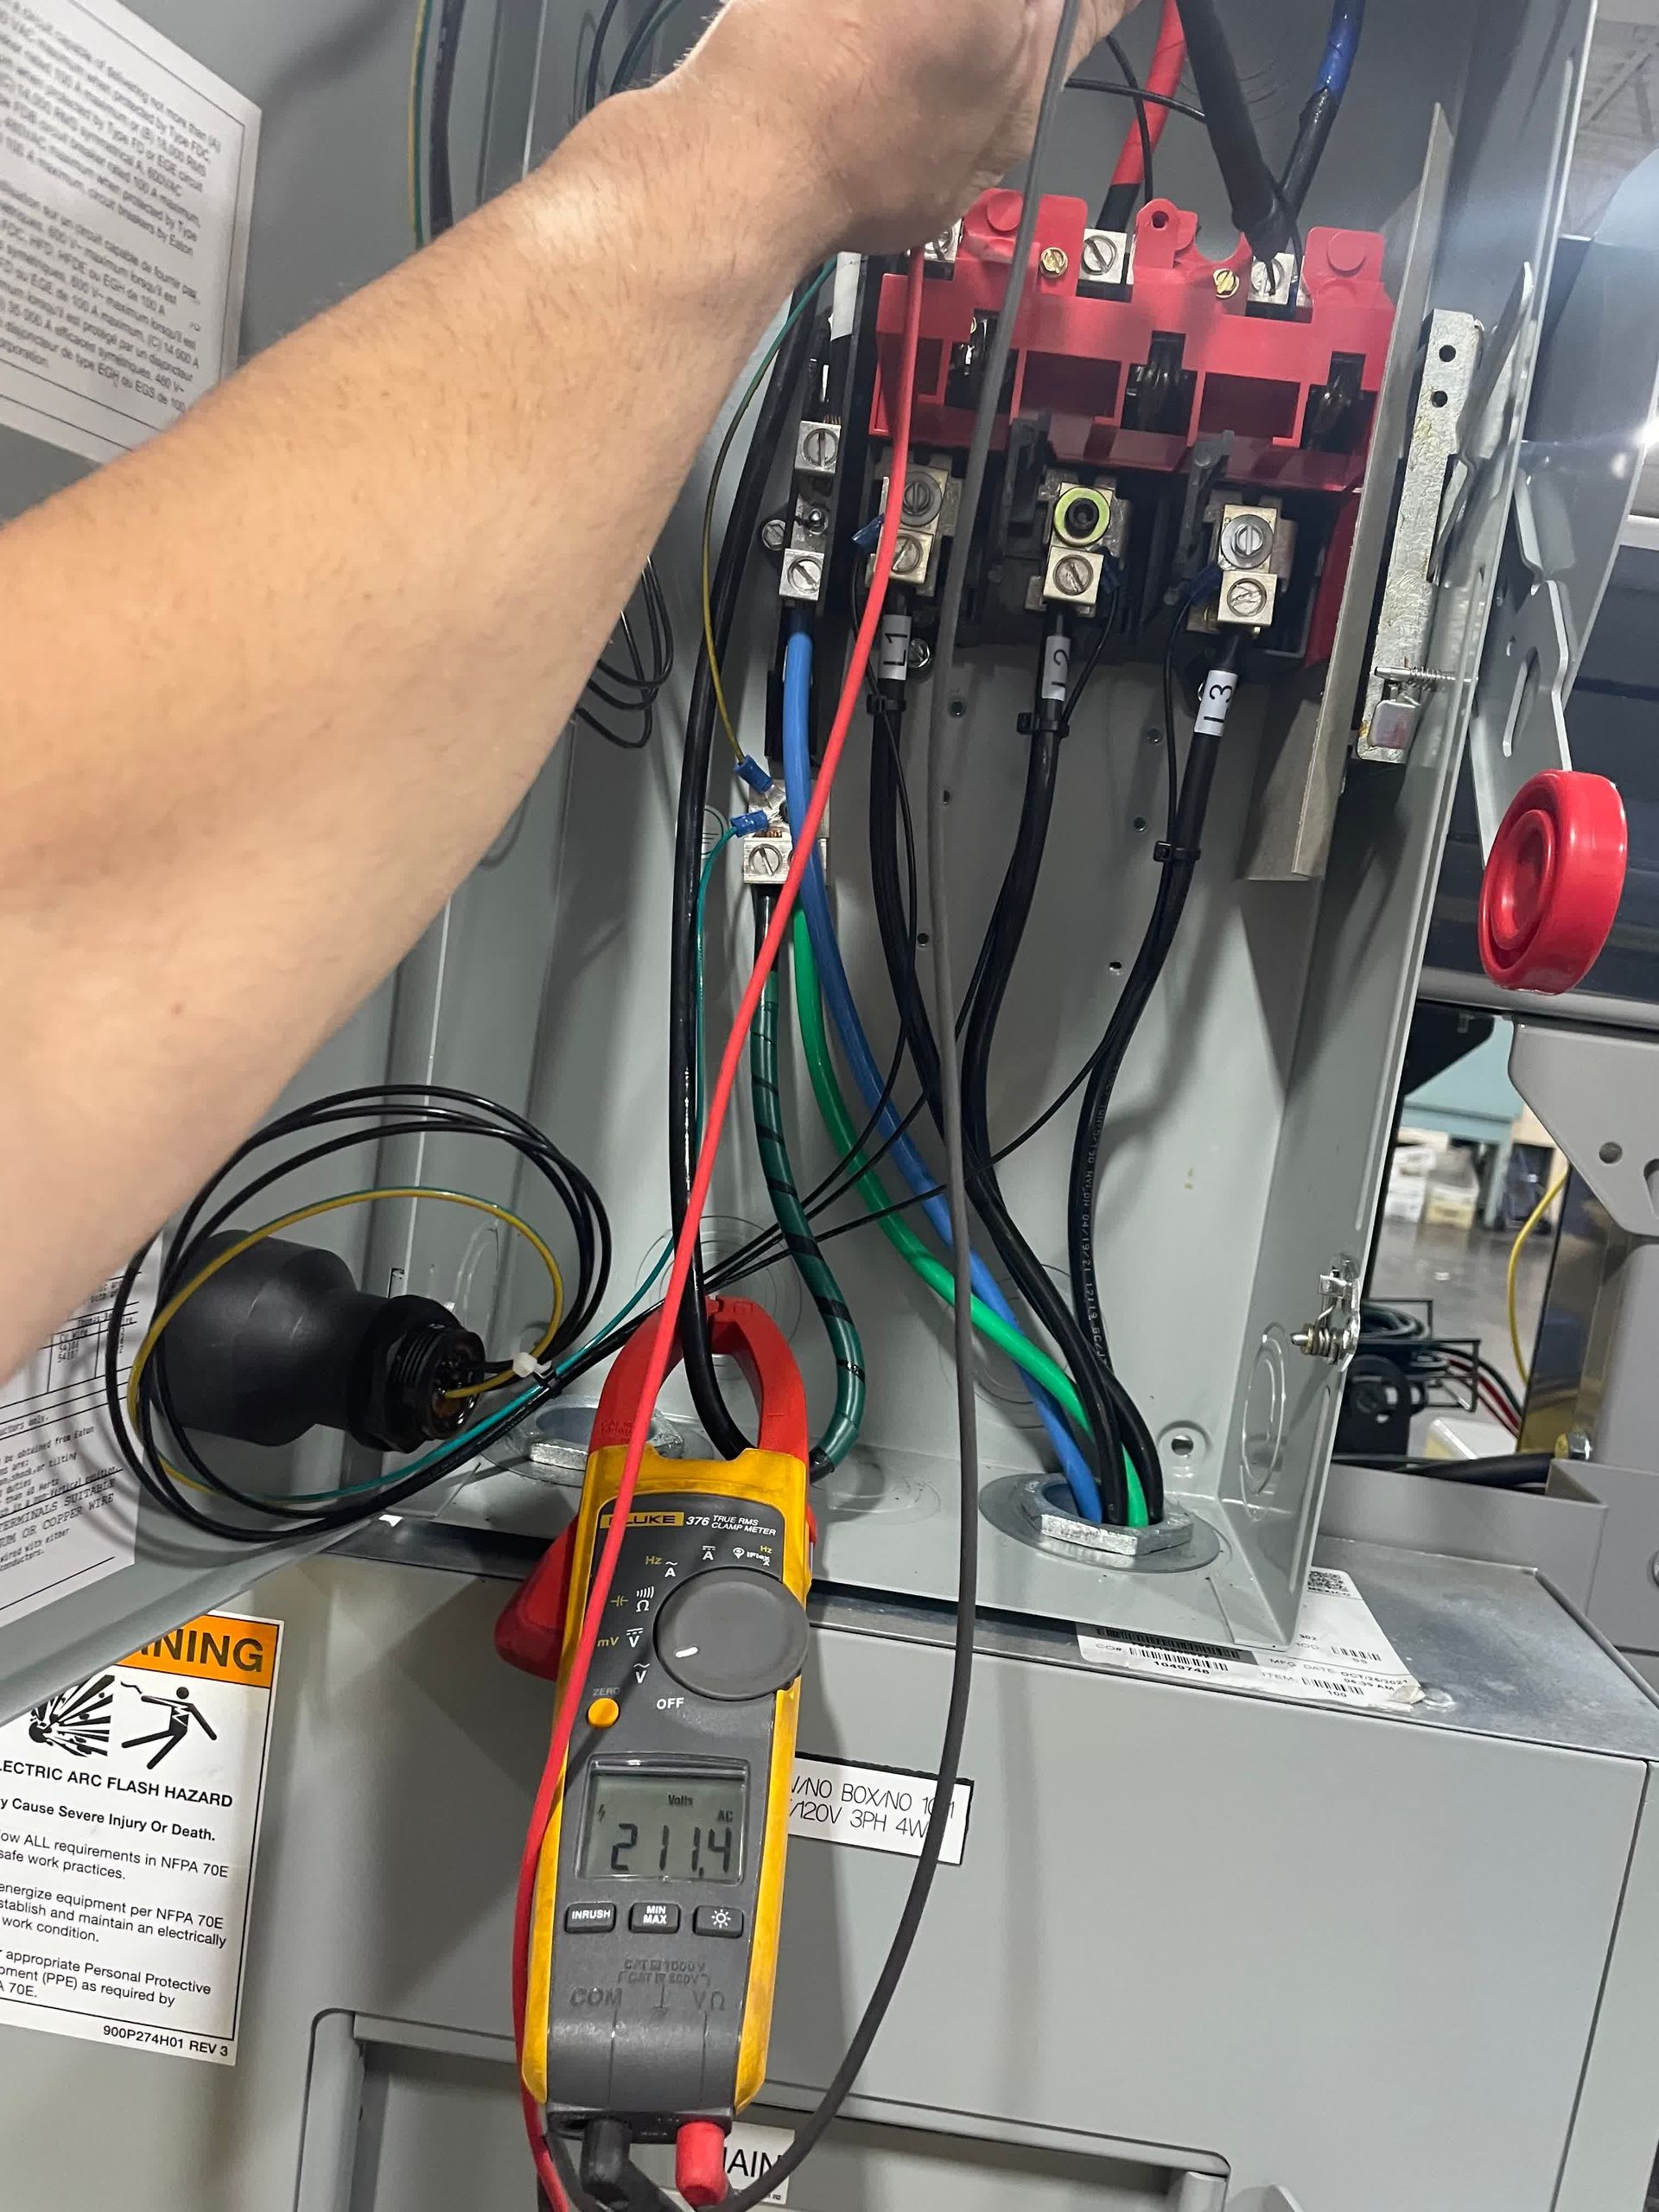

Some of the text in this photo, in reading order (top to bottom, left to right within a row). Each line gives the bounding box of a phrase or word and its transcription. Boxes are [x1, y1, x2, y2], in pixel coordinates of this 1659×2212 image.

[883, 632, 908, 666] L1
[42, 1506, 83, 1529] COPPER
[89, 1493, 114, 1510] WIRE
[608, 1515, 710, 1526] LUKE 376
[712, 1515, 760, 1527] TRUE RMS
[711, 1522, 777, 1536] CLAMP METER
[645, 1556, 663, 1567] Hz
[141, 1629, 264, 1672] NING
[597, 1637, 620, 1648] mV
[1270, 1658, 1296, 1668] MFG
[1303, 1663, 1336, 1674] DATE
[593, 1687, 620, 1696] ZERO
[657, 1697, 684, 1710] OFF
[0, 1760, 233, 1808] ECTRIC ARC FLASH HAZARD
[842, 1783, 912, 1812] BOX/NO
[668, 1794, 694, 1807] Volts
[12, 1798, 55, 1815] Cause
[59, 1805, 105, 1823] Severe
[109, 1813, 147, 1832] Injury
[150, 1820, 168, 1834] Or
[172, 1823, 216, 1841] Death.
[717, 1809, 734, 1822] AC
[790, 1800, 930, 1839] /120V 3PH 4W
[24, 1834, 50, 1849] ALL
[54, 1840, 141, 1864] requirements
[145, 1853, 156, 1866] in
[161, 1855, 199, 1873] NFPA
[203, 1863, 229, 1878] 70E
[611, 1822, 733, 1878] 211.4
[28, 1853, 60, 1868] work
[63, 1859, 126, 1880] practices.
[56, 1891, 127, 1914] equipment
[130, 1904, 153, 1918] per
[156, 1908, 194, 1924] NFPA
[198, 1915, 224, 1929] 70E
[571, 1909, 611, 1920] INRUSH
[643, 1915, 667, 1925] MAX
[646, 1905, 666, 1916] MIN
[2, 1916, 99, 1943] work condition.
[50, 1906, 74, 1921] and
[79, 1911, 134, 1932] maintain
[137, 1923, 154, 1936] an
[157, 1925, 226, 1949] electrically
[6, 1949, 212, 1995] appropriate Personal Protective
[9, 1981, 37, 1999] 70E.
[42, 1971, 79, 1990] (PPE)
[81, 1979, 98, 1992] as
[101, 1983, 155, 2003] required
[159, 1992, 176, 2008] by
[569, 1987, 622, 2007] COM
[103, 2025, 229, 2057] 900P274H01 REV 3
[723, 2147, 782, 2177] AIN
